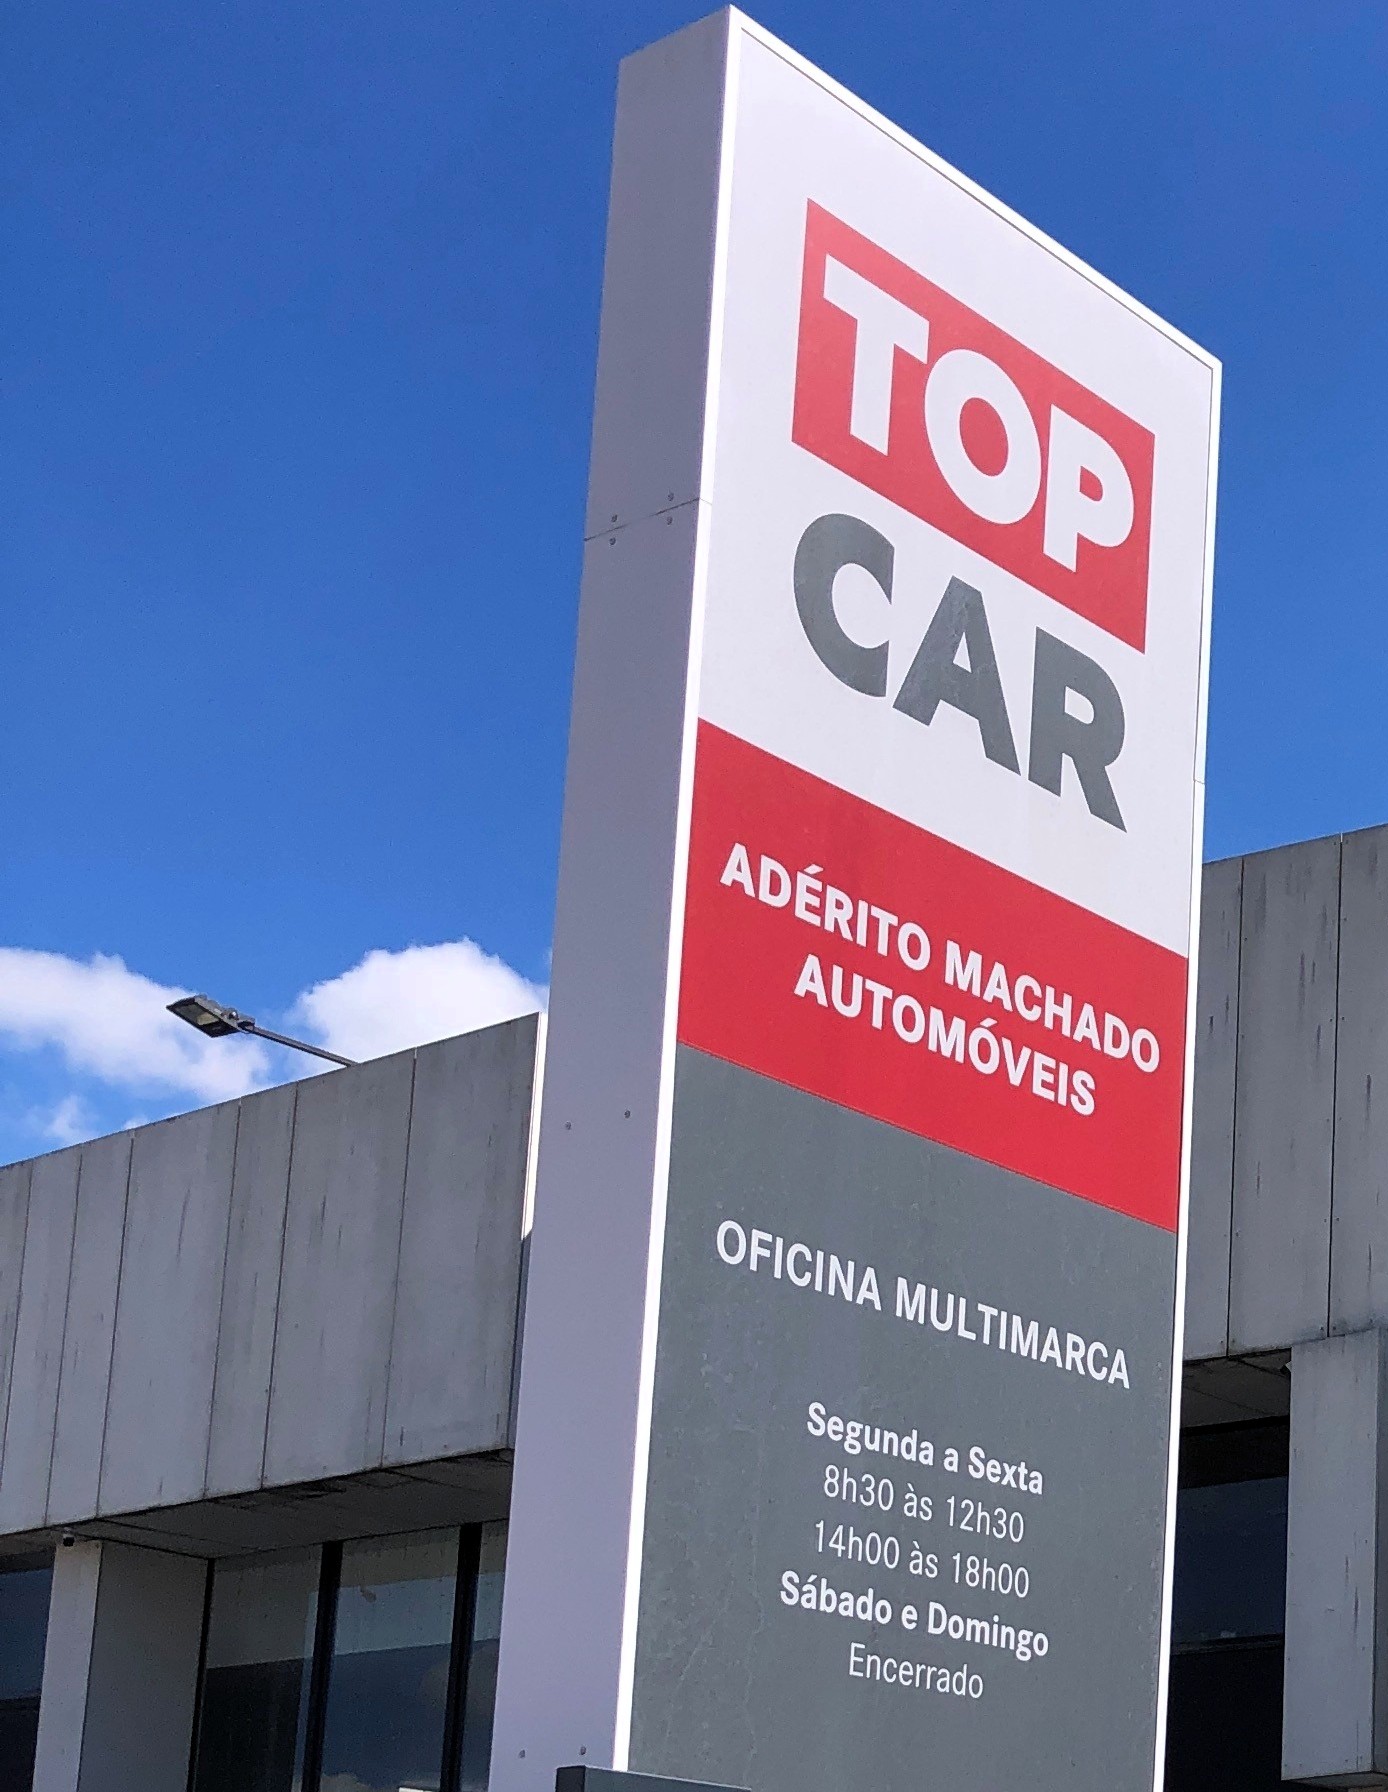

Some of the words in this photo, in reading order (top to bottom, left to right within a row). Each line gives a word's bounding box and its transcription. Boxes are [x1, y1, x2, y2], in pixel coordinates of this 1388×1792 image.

[823, 253, 1135, 573] TOP
[793, 512, 1128, 833] CAR
[719, 842, 931, 971] ADÉRITO
[944, 939, 1160, 1073] MACHADO
[793, 953, 1096, 1116] AUTOMÓVEIS
[716, 1220, 882, 1311] OFICINA
[895, 1276, 1130, 1390] MULTIMARCA
[806, 1401, 934, 1466] Segunda
[943, 1447, 959, 1473] a
[968, 1446, 1043, 1495] Sexta
[823, 1464, 894, 1511] 8h30
[903, 1482, 933, 1521] às
[946, 1495, 1024, 1543] 12h30
[780, 1570, 893, 1625] Sábado
[901, 1604, 918, 1630] e
[927, 1601, 1049, 1662] Domingo
[815, 1519, 900, 1569] 14h00
[909, 1540, 939, 1579] às
[952, 1552, 1030, 1598] 18h00
[848, 1641, 984, 1699] Encerrado
